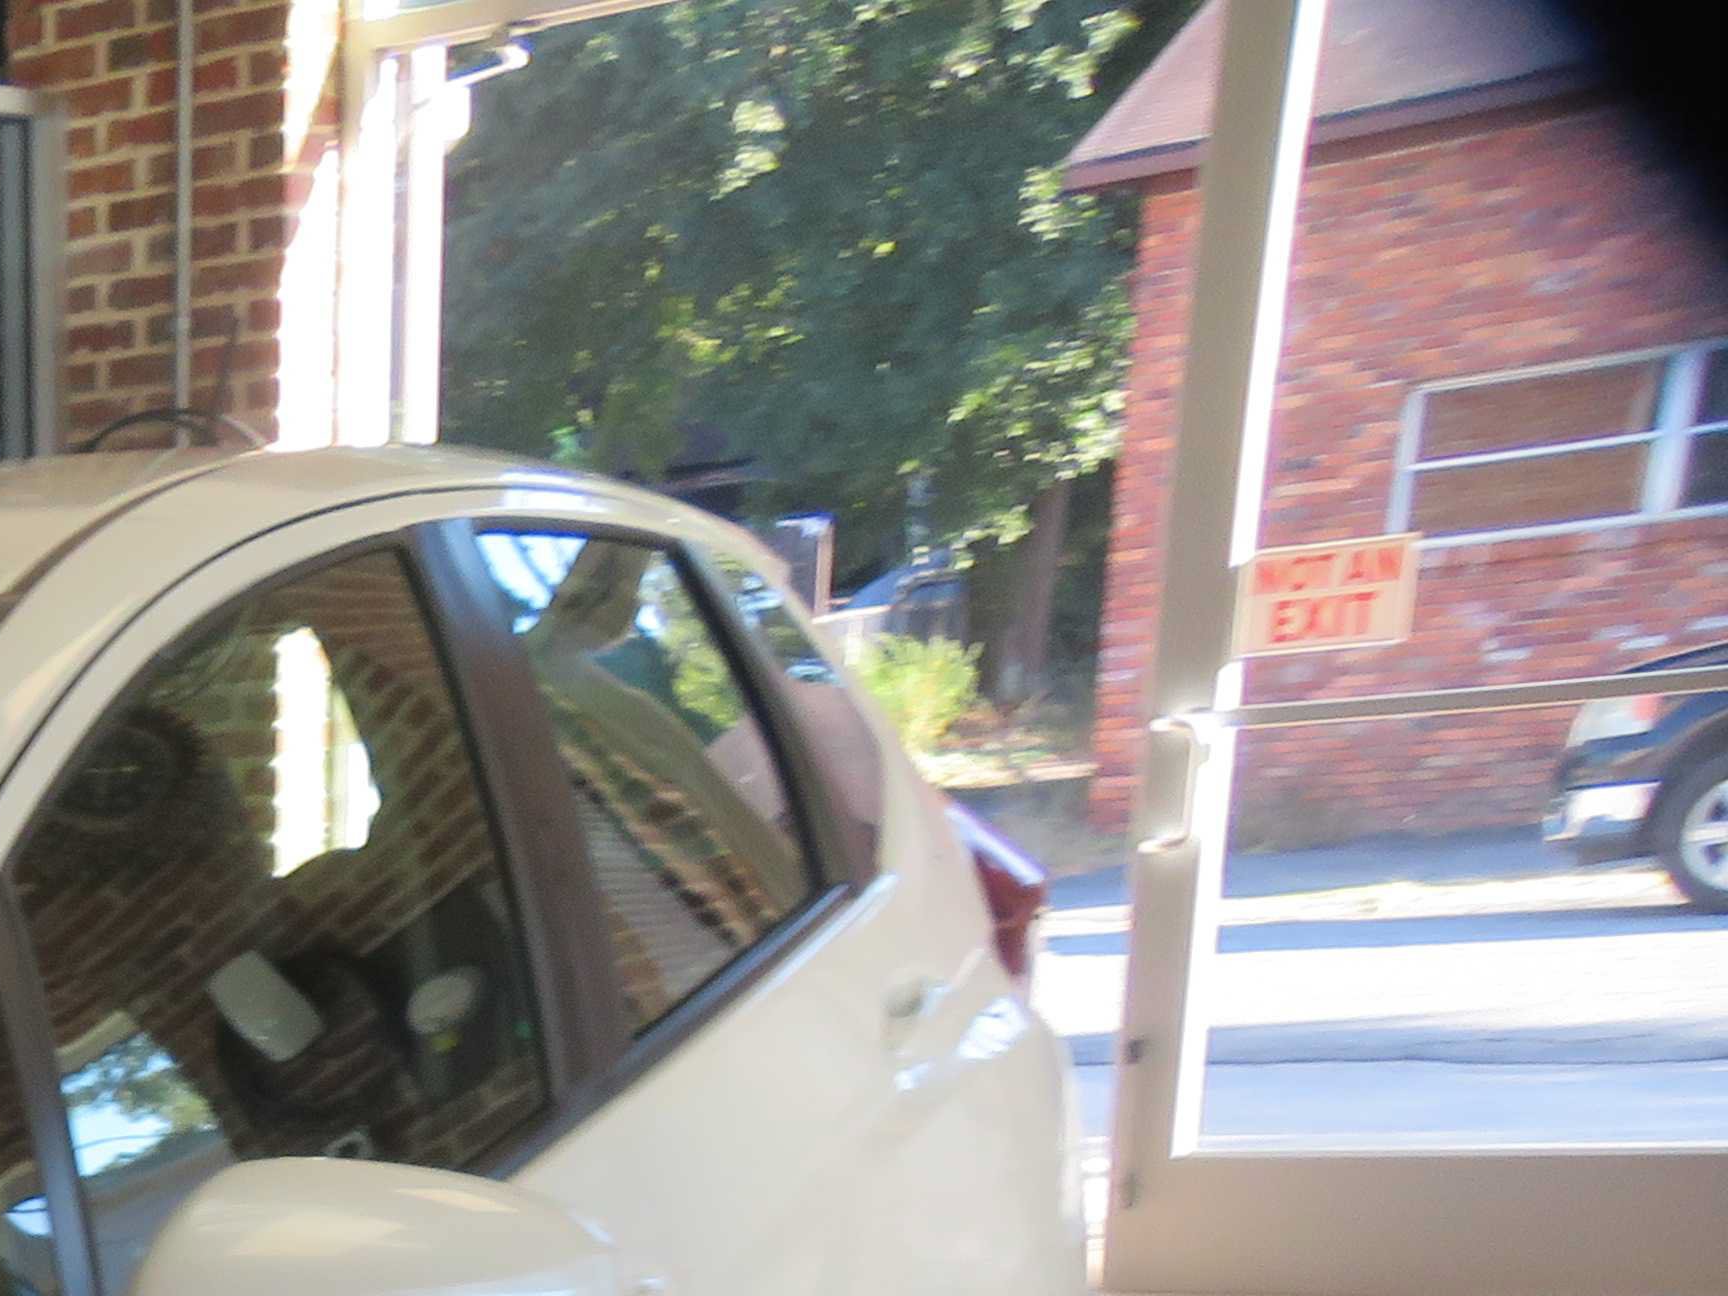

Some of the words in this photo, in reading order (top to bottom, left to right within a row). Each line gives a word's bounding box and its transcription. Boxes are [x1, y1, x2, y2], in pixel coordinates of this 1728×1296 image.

[1252, 553, 1337, 594] NOT
[1345, 545, 1402, 582] AN
[1269, 590, 1378, 643] EXIT
